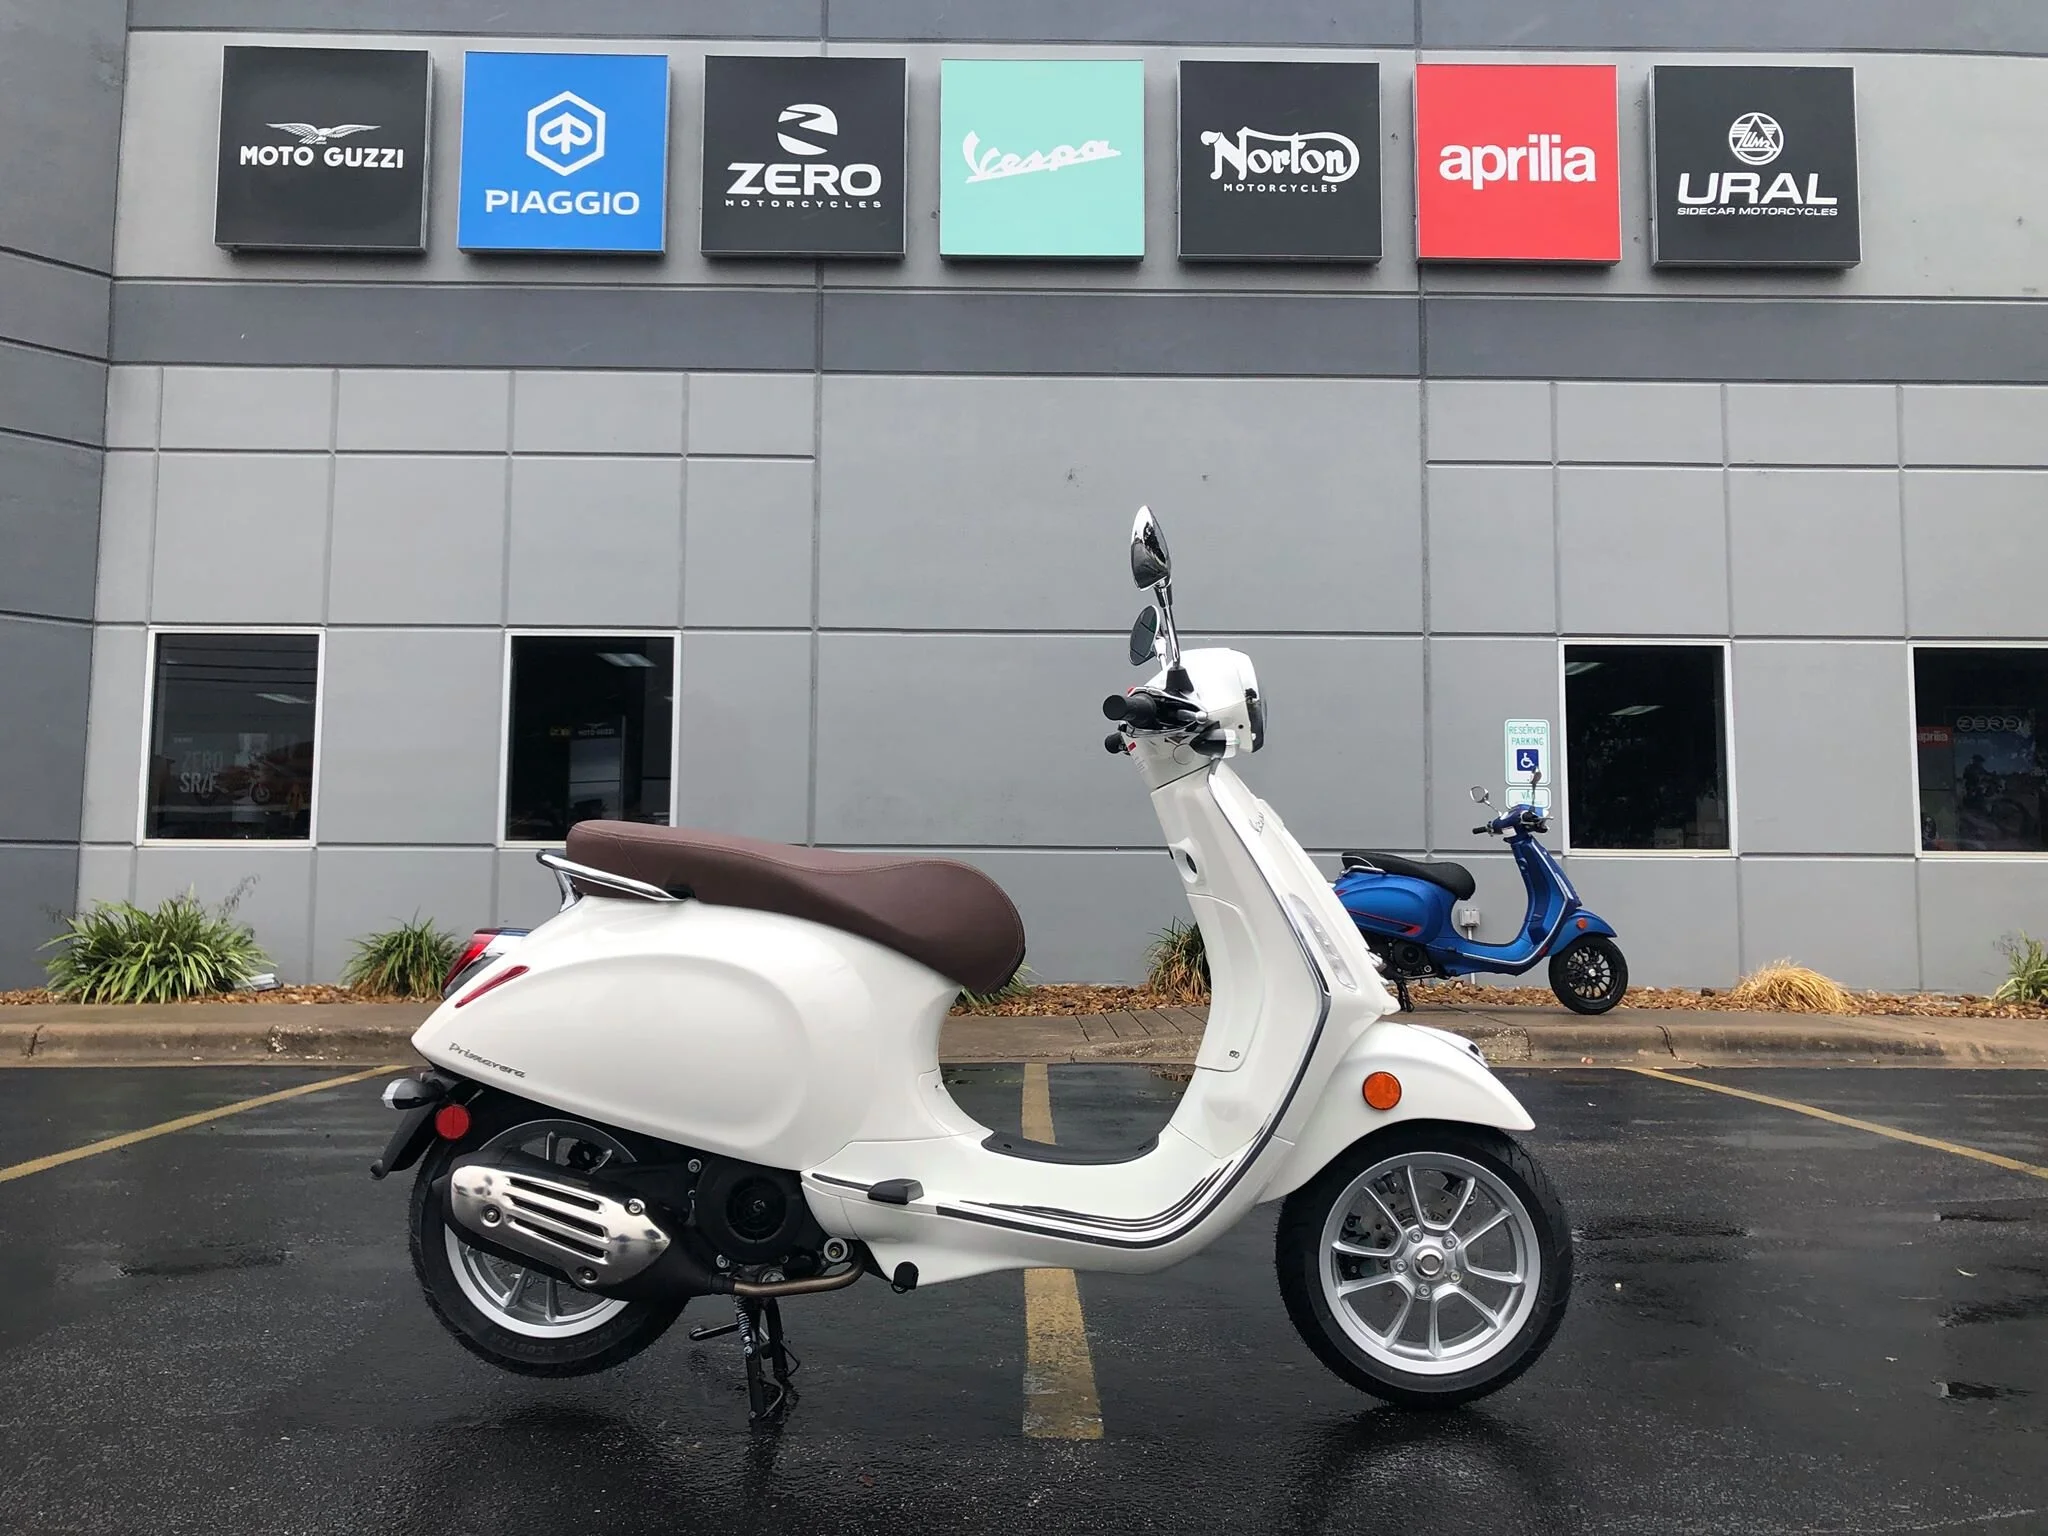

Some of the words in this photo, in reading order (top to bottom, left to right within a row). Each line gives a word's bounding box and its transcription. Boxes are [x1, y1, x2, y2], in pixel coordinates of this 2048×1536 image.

[239, 145, 314, 167] MOTO
[323, 147, 404, 169] GUZZI
[962, 130, 1122, 184] Vespa
[1200, 126, 1360, 183] Norton
[1439, 133, 1597, 190] aprilia
[726, 162, 882, 196] ZERO
[1223, 183, 1338, 193] MOTORCYCLES
[1677, 172, 1838, 205] URAL
[485, 189, 640, 215] PIAGGIO
[725, 199, 882, 208] MOTORCYCLES
[1677, 207, 1736, 216] SIDECAR
[1738, 207, 1839, 216] MOTORCYCLES
[1508, 726, 1546, 735] RESERVED
[1511, 737, 1544, 746] PARKING
[448, 1042, 527, 1078] Primavera
